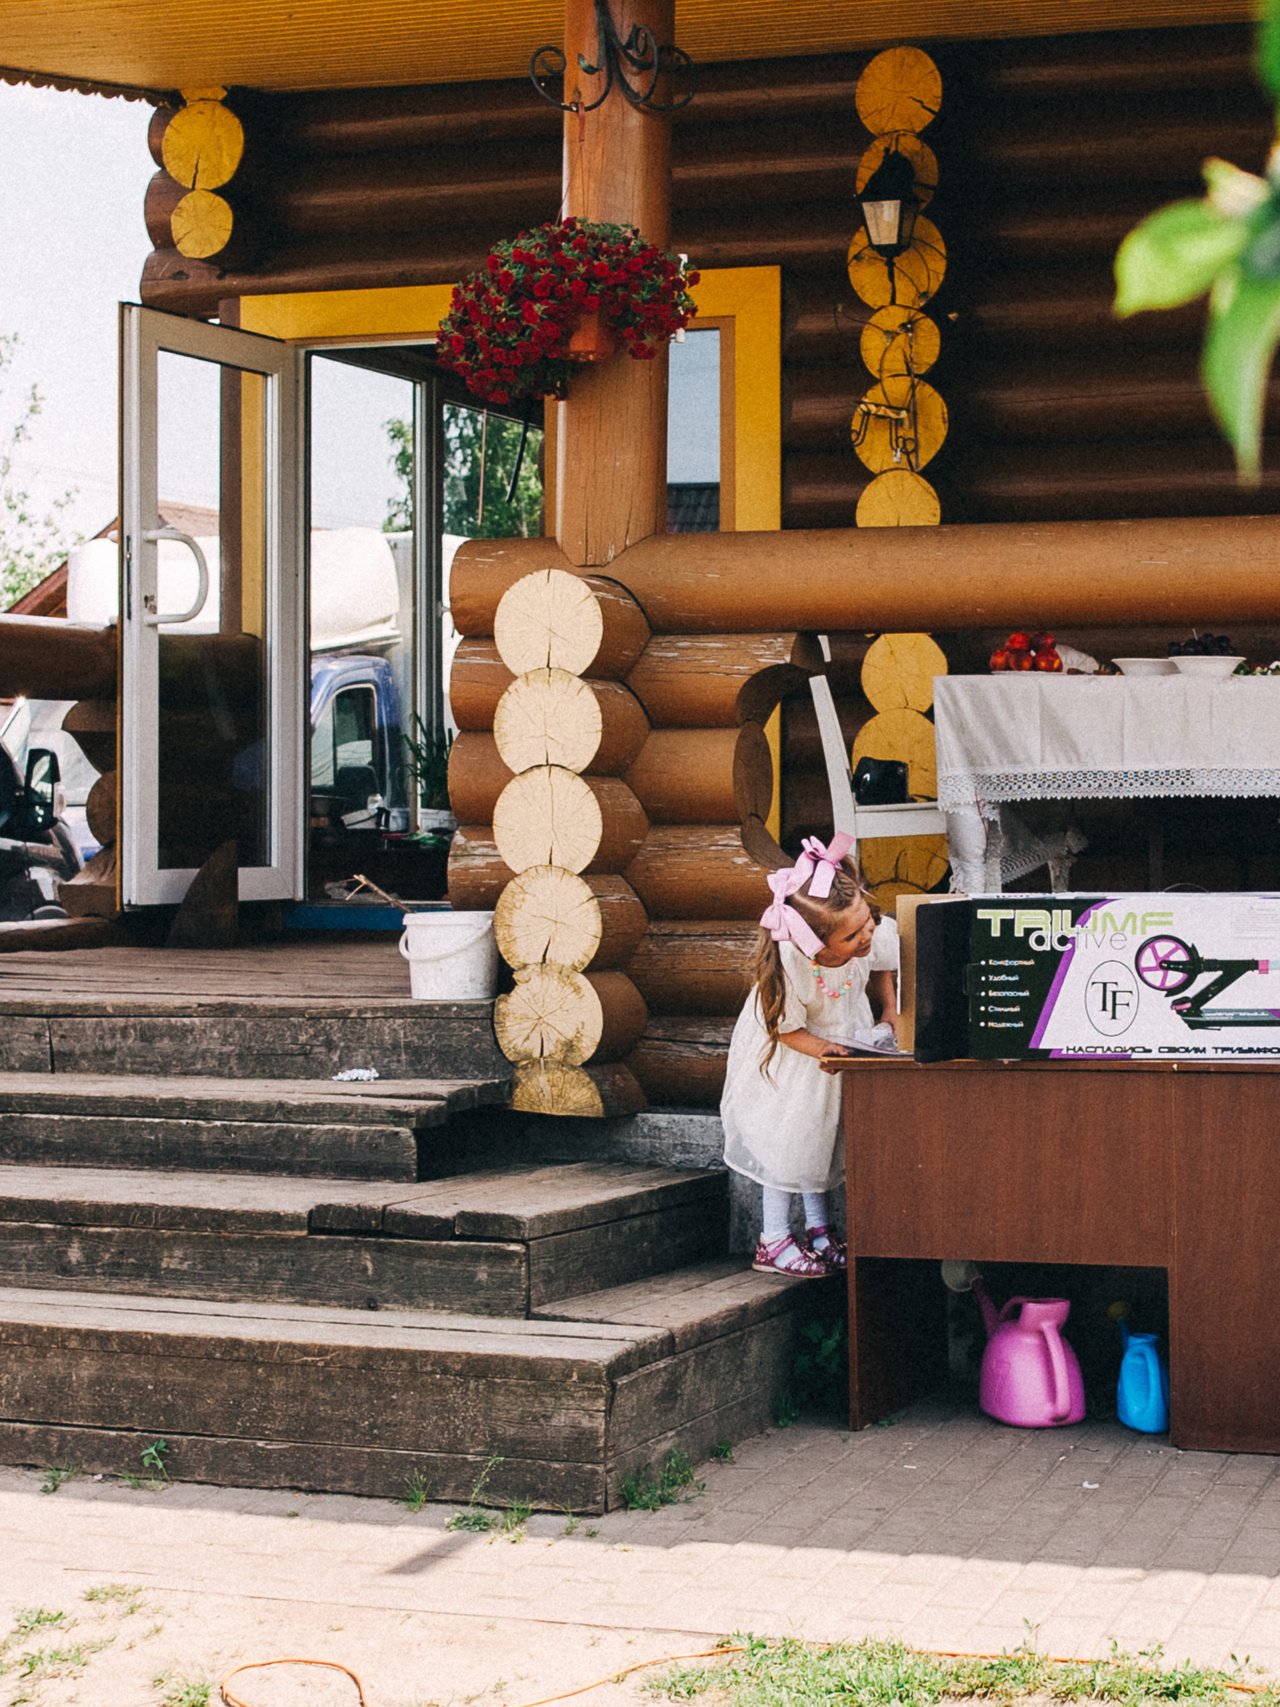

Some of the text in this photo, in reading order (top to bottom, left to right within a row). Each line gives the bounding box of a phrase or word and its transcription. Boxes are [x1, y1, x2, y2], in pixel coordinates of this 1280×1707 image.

[977, 909, 1174, 937] TRIUMF
[1028, 925, 1128, 951] active
[1091, 981, 1133, 1020] TF
